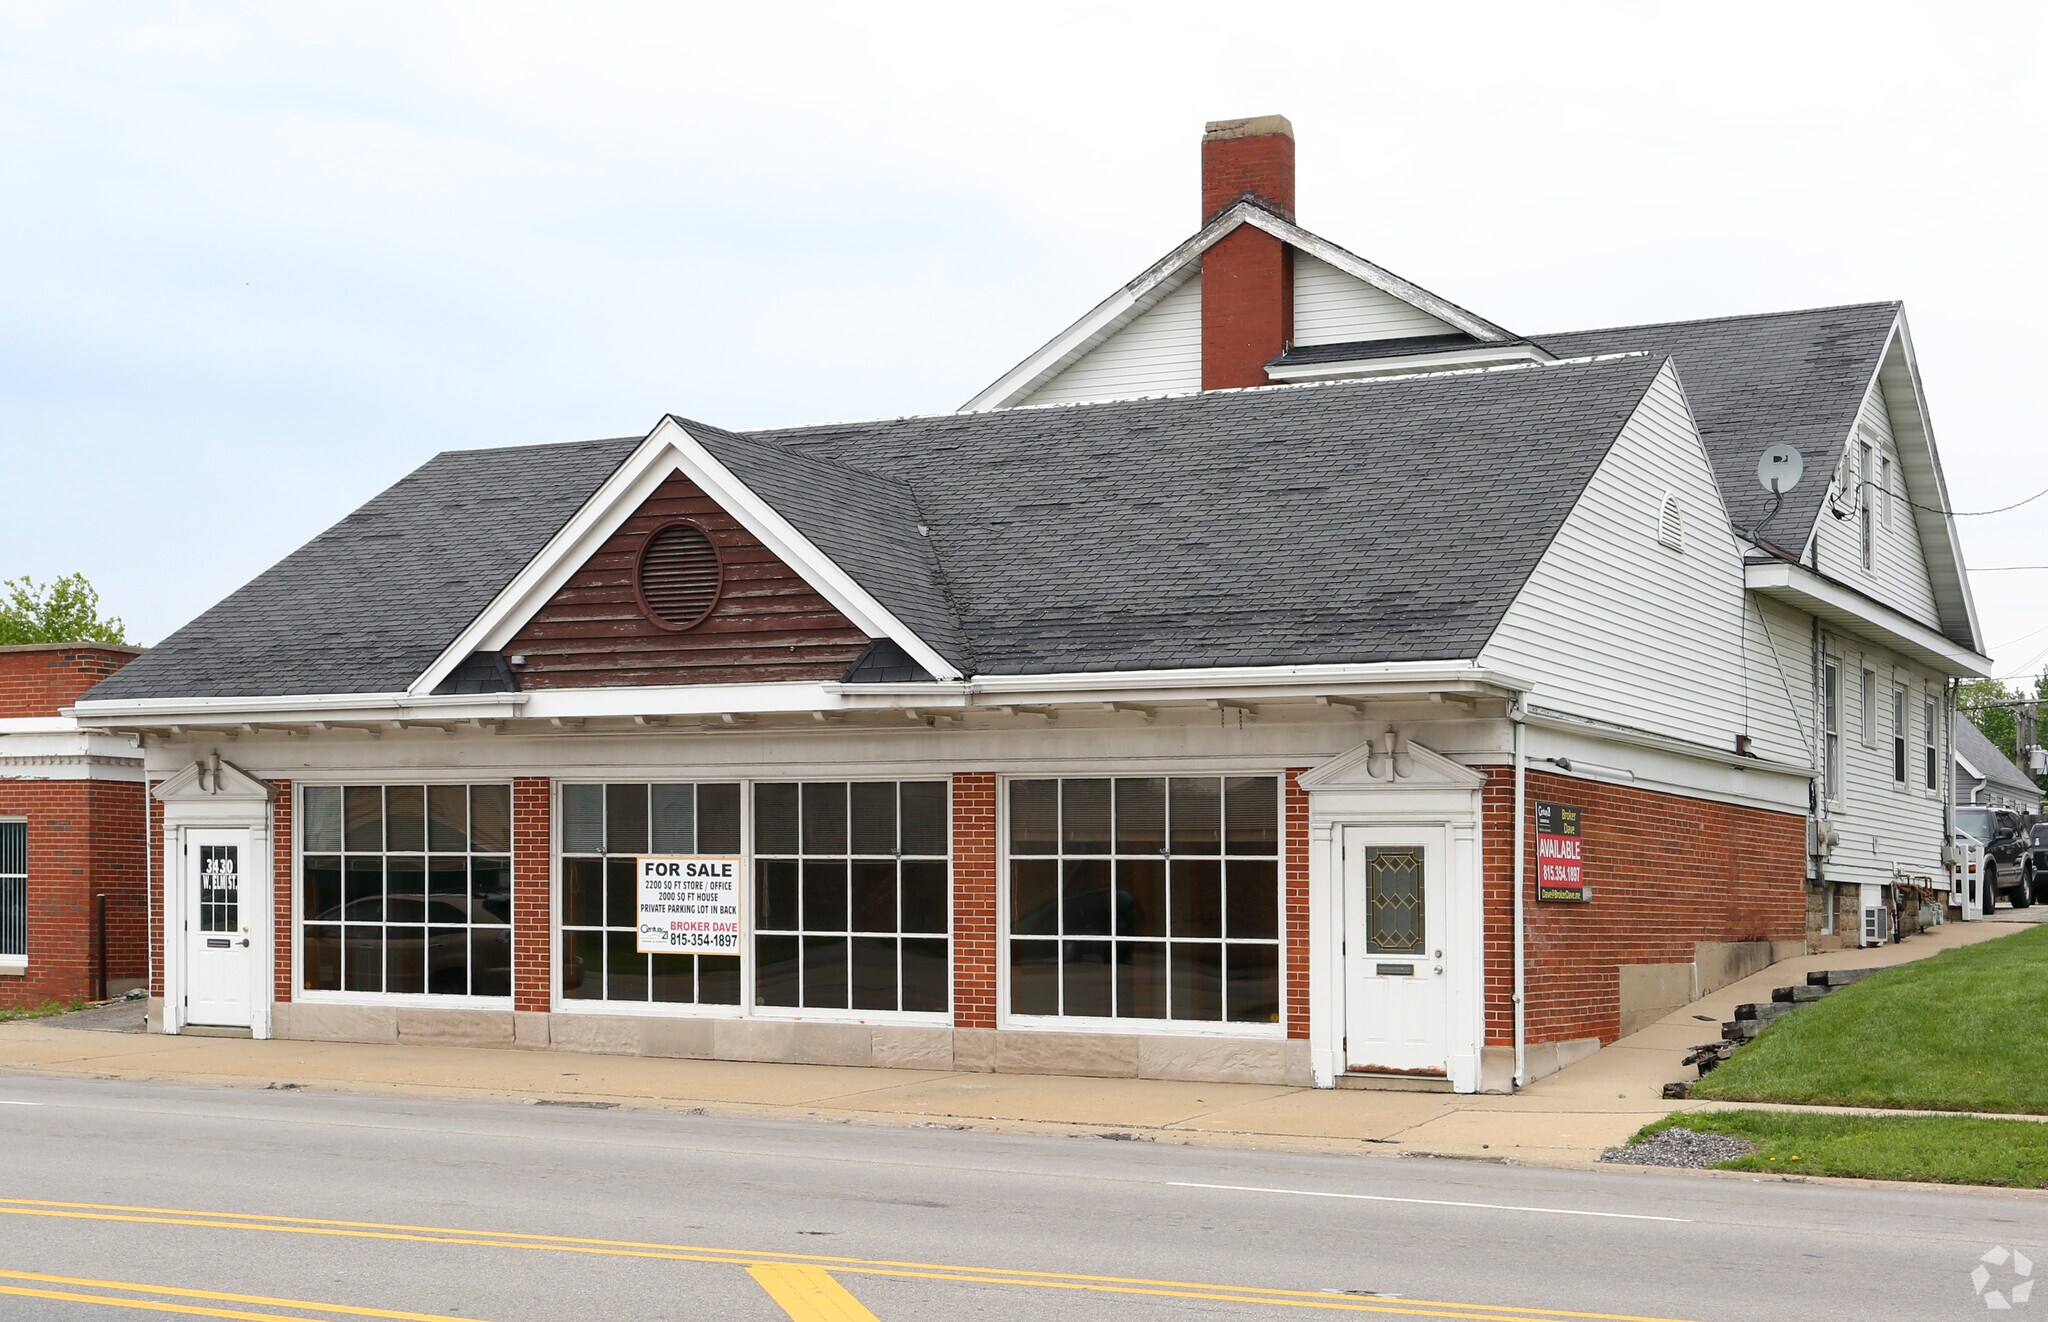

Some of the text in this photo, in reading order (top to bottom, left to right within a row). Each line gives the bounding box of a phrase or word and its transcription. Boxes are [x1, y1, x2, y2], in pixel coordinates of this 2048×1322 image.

[1562, 809, 1576, 821] Broker
[1564, 823, 1575, 834] Dave
[1540, 838, 1581, 860] AVAILABLE
[206, 858, 233, 874] 3430
[645, 863, 732, 877] FOR SALE
[1543, 865, 1580, 882] 815.354.1897
[202, 875, 212, 890] W.
[213, 875, 226, 890] ELM
[646, 880, 662, 889] 2200
[664, 881, 672, 890] SQ
[674, 881, 682, 890] FT
[684, 881, 703, 890] STORE
[710, 882, 732, 891] OFFICE
[658, 892, 718, 902] 2000 SQ FT HOUSE
[640, 904, 736, 915] PRIVATE PARKING LOT IN BACK
[640, 924, 664, 934] Century
[670, 921, 738, 932] BROKER DAVE
[661, 930, 668, 940] 21
[670, 932, 738, 948] 815-354-1897
